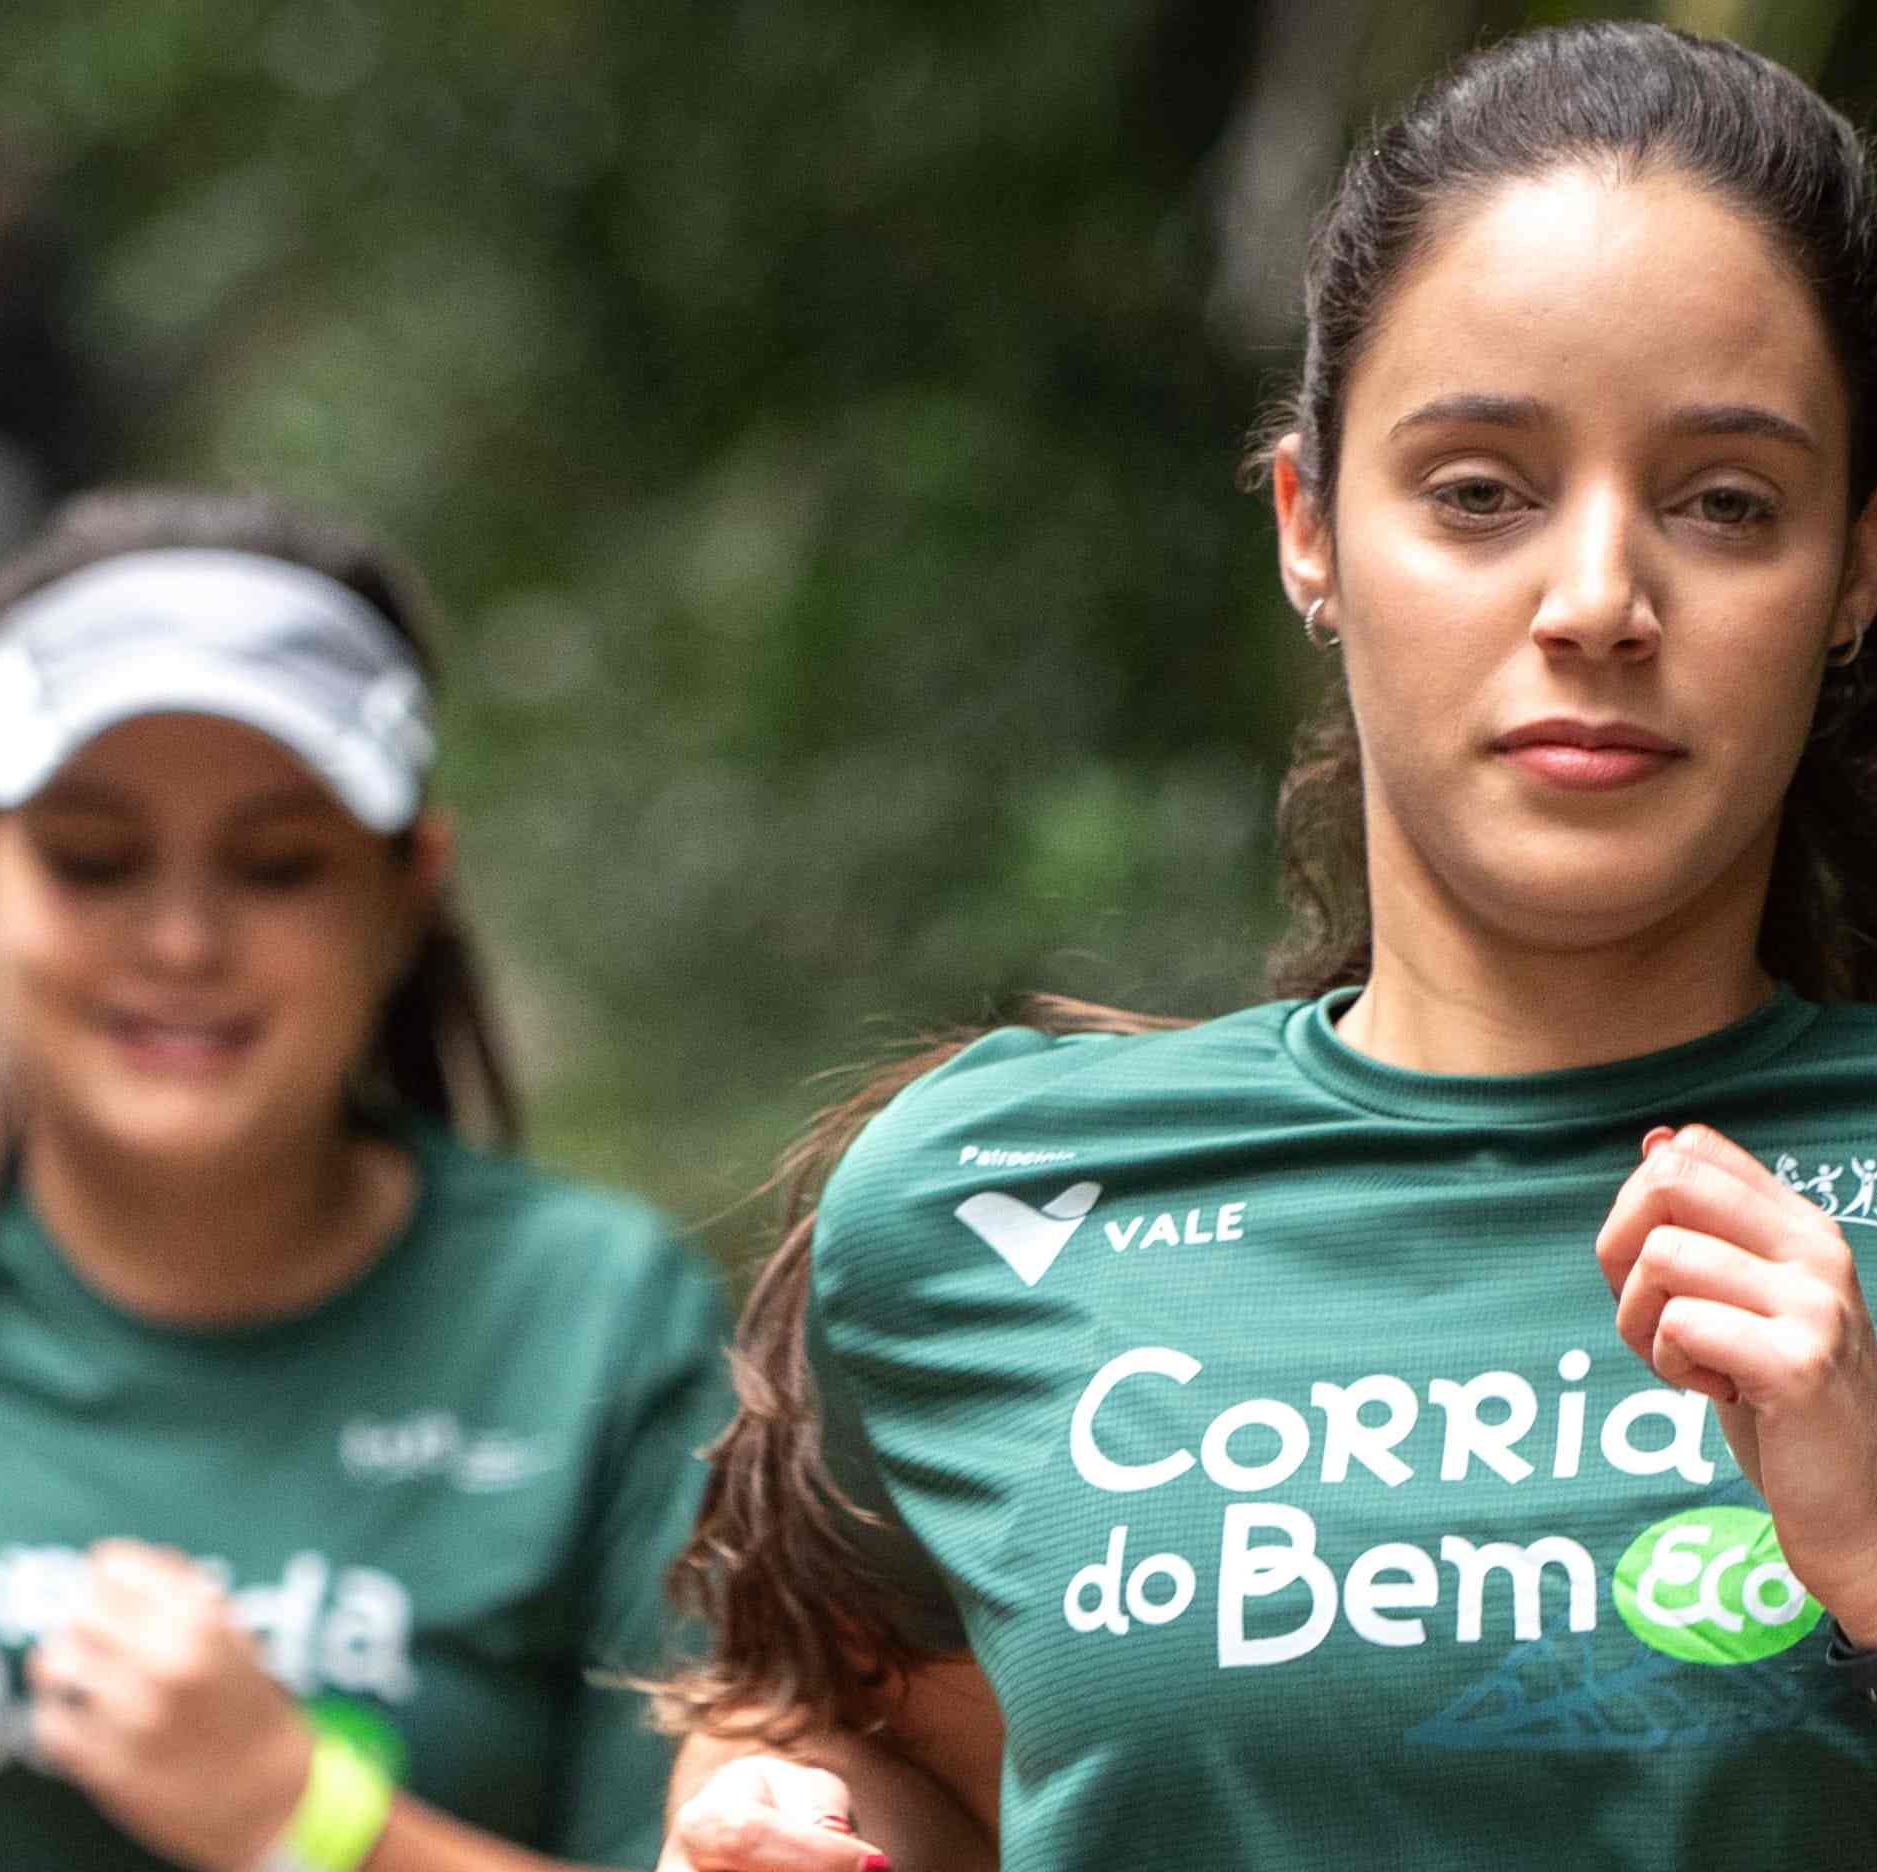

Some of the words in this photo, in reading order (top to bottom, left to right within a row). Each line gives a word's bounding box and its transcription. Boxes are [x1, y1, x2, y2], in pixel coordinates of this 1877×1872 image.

[1103, 1201, 1247, 1253] VALE
[1063, 1524, 1195, 1637] do
[1218, 1500, 1598, 1669] Bem
[1636, 1524, 1807, 1634] Eco
